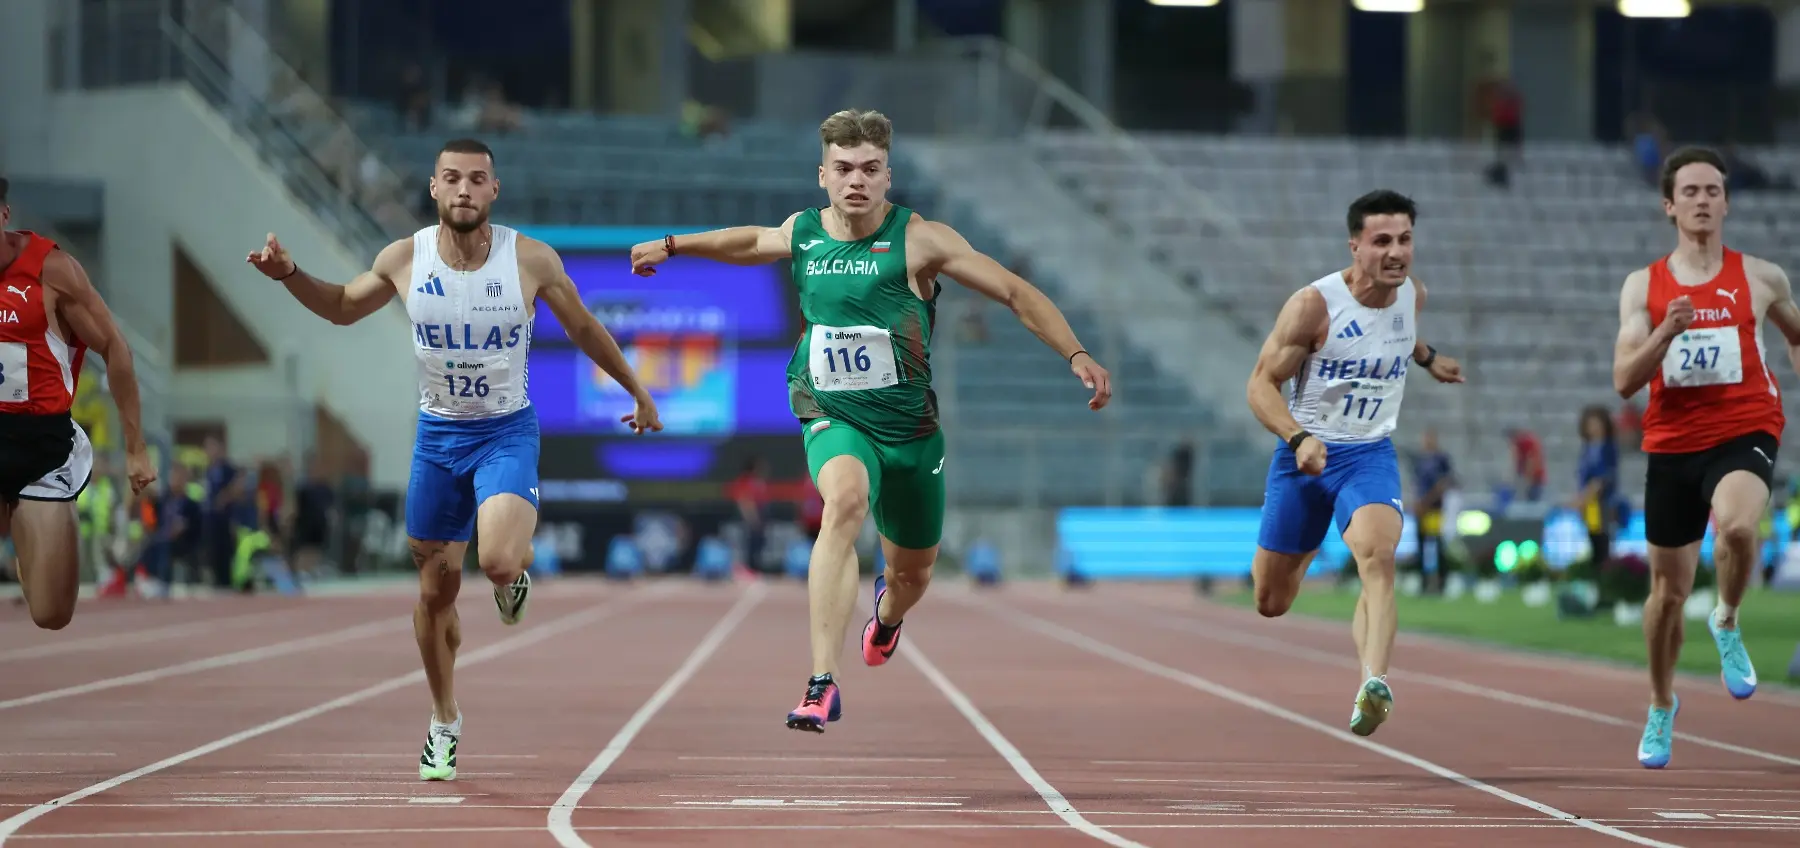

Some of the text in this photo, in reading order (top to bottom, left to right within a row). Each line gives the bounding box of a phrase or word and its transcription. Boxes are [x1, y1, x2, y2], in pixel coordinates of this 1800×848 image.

[806, 259, 879, 276] BULGARIA
[0, 309, 19, 323] IA
[416, 323, 522, 350] HELLAS
[834, 331, 862, 341] allwyn
[457, 361, 484, 370] allwyn
[823, 345, 871, 373] 116
[1680, 346, 1720, 370] 247
[444, 374, 490, 398] 126
[1343, 394, 1383, 421] 117
